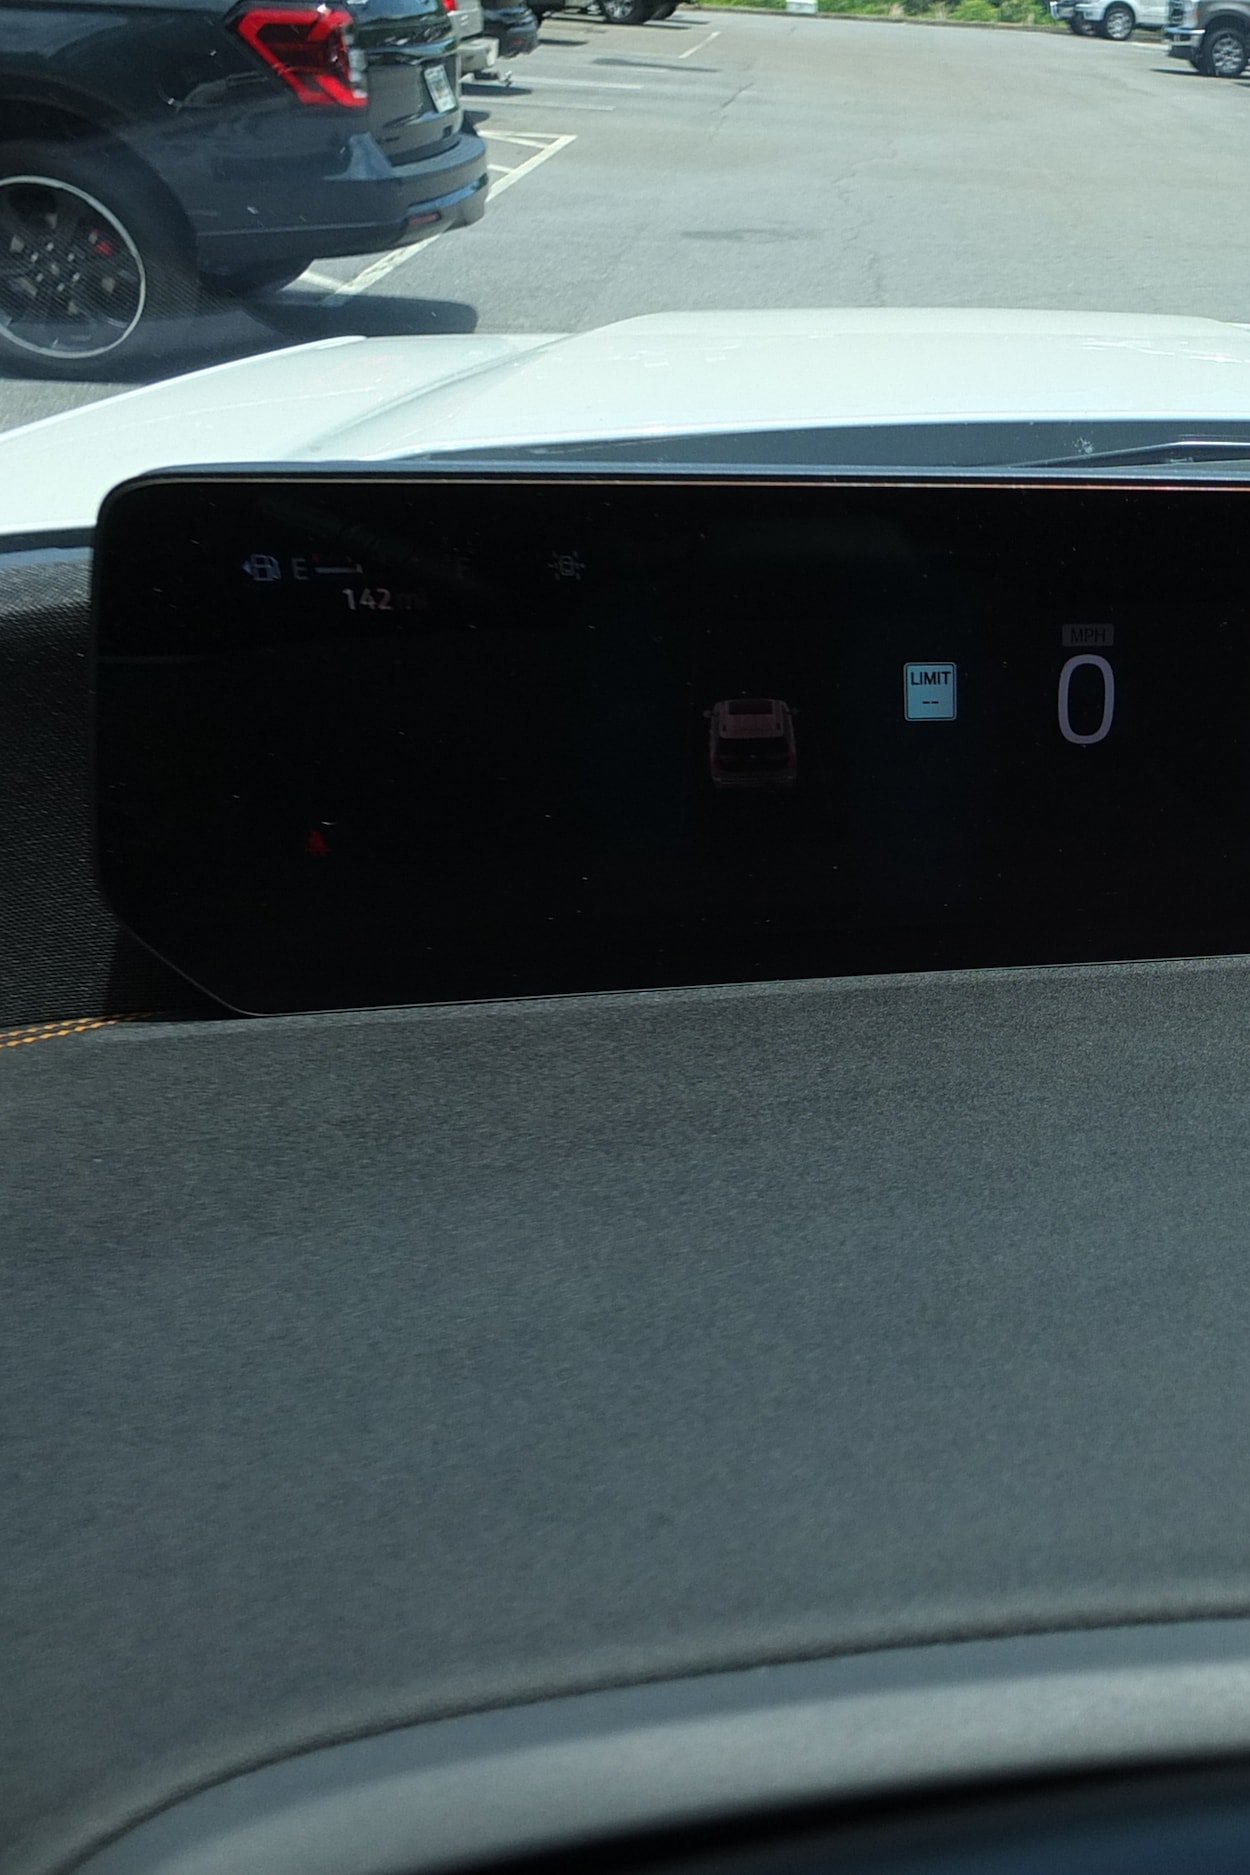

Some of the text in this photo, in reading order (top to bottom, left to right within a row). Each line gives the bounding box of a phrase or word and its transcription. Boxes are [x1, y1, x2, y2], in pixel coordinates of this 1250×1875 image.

[290, 556, 311, 581] E
[342, 587, 395, 611] 142
[1070, 628, 1106, 644] MPH
[910, 671, 952, 686] LIMIT
[1057, 653, 1116, 745] 0
